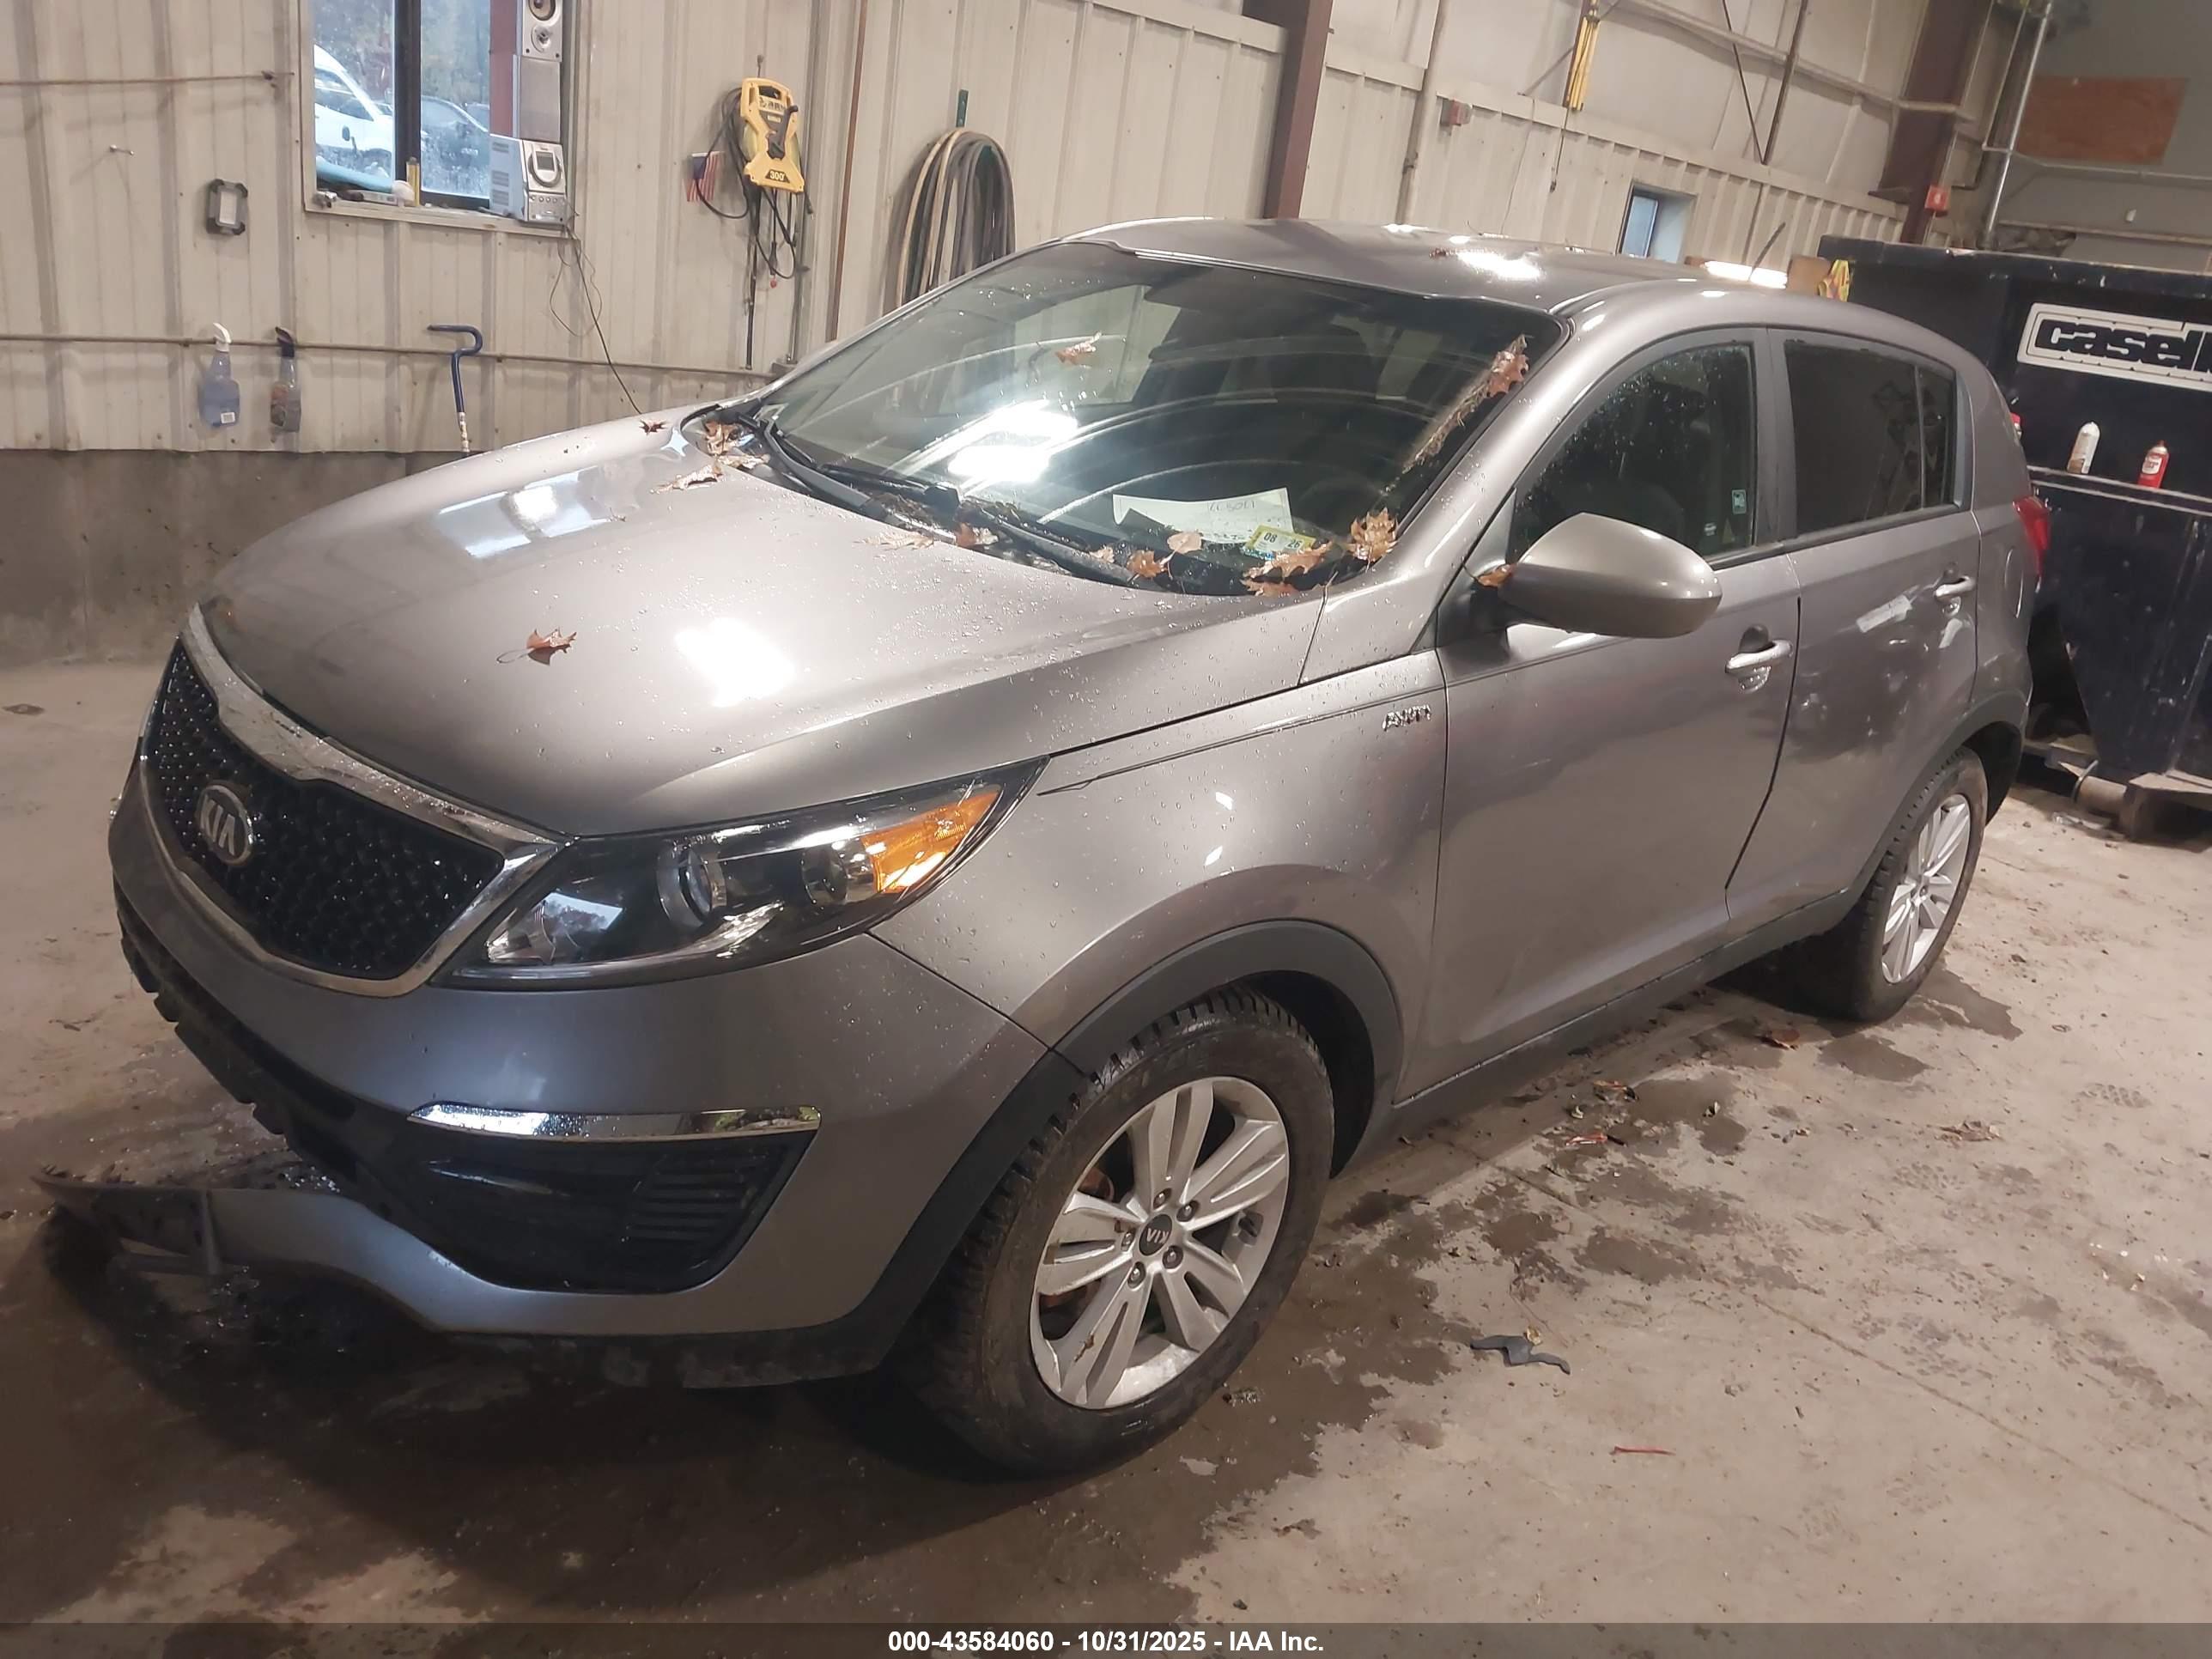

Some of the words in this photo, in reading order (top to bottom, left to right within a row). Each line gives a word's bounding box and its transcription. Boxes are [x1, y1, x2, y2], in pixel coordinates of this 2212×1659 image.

[1263, 532, 1278, 544] 08
[1288, 538, 1301, 550] 26
[199, 793, 236, 857] KIA
[1146, 1227, 1169, 1243] KIA
